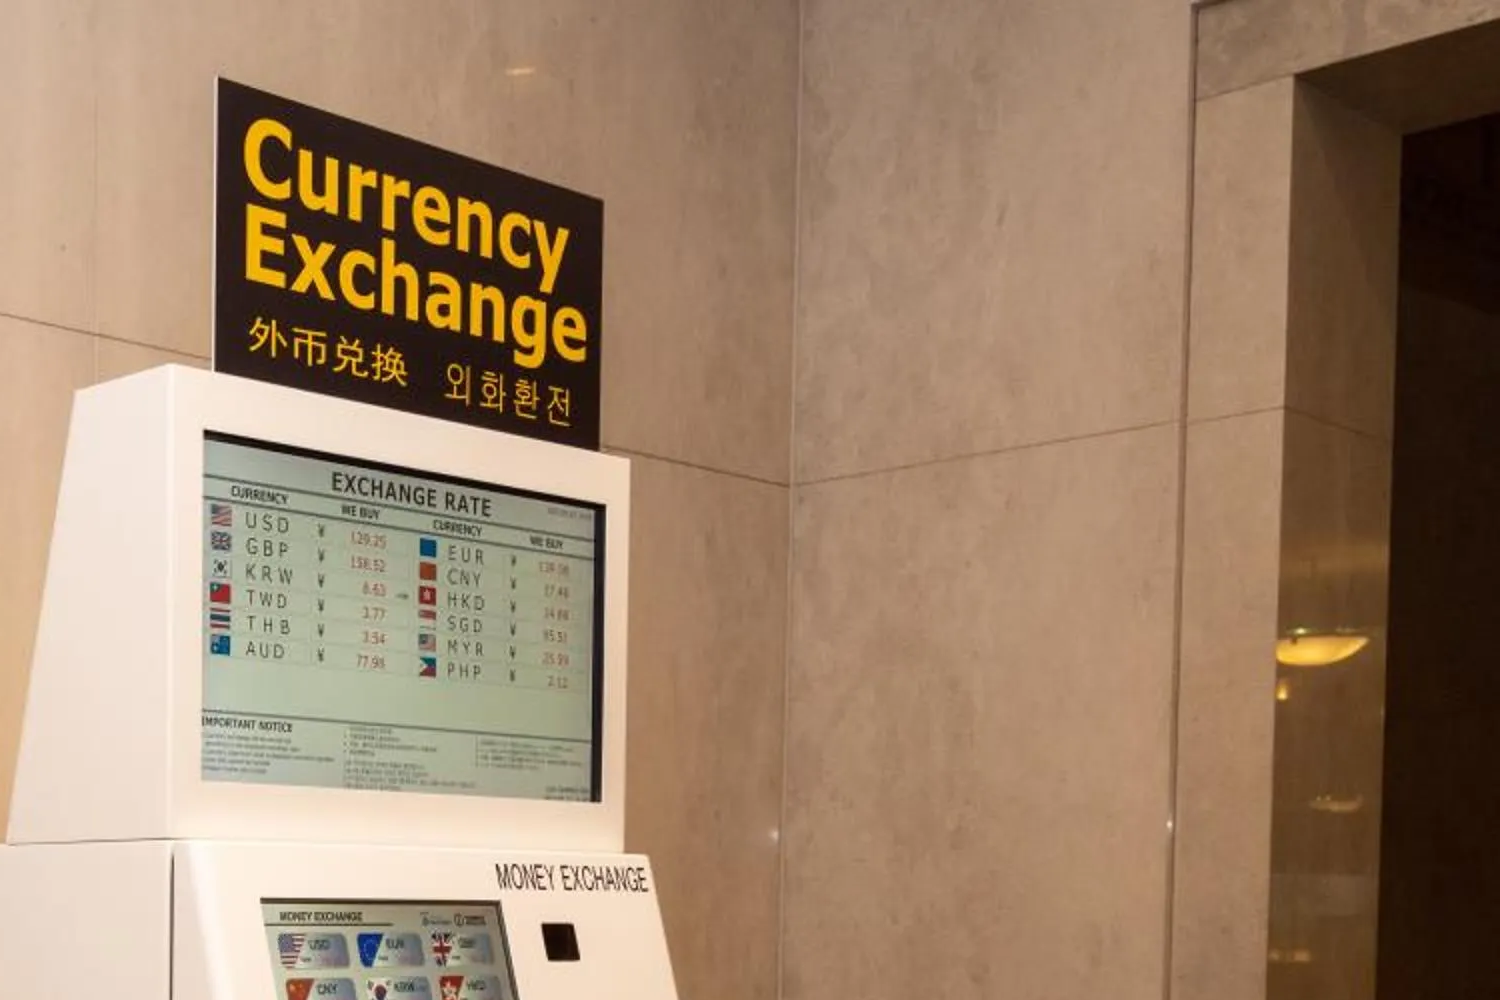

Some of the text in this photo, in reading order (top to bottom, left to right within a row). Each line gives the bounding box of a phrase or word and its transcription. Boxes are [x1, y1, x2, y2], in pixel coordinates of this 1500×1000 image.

[243, 118, 569, 293] Currency
[245, 202, 586, 369] Exchange
[248, 316, 408, 387] 外币兑换
[444, 363, 571, 427] 외화환전
[331, 471, 492, 517] EXCHANGE RATE
[231, 485, 289, 504] CURRENCY
[341, 505, 357, 516] WE
[360, 507, 380, 520] BUY
[433, 519, 483, 537] CURRENCY
[246, 512, 289, 533] USD
[246, 538, 289, 558] GBP
[448, 545, 484, 566] EUR
[246, 564, 293, 584] KRW
[447, 568, 481, 588] CNY
[246, 589, 287, 609] TWD
[447, 592, 485, 611] HKD
[247, 616, 290, 635] THB
[447, 616, 483, 633] SGD
[246, 641, 285, 659] AUD
[448, 640, 484, 656] MYR
[448, 663, 481, 679] PHP
[202, 716, 293, 733] IMPORTANT NOTICE
[495, 863, 650, 892] MONEY EXCHANGE
[280, 911, 363, 922] MONEY EXCHANGE
